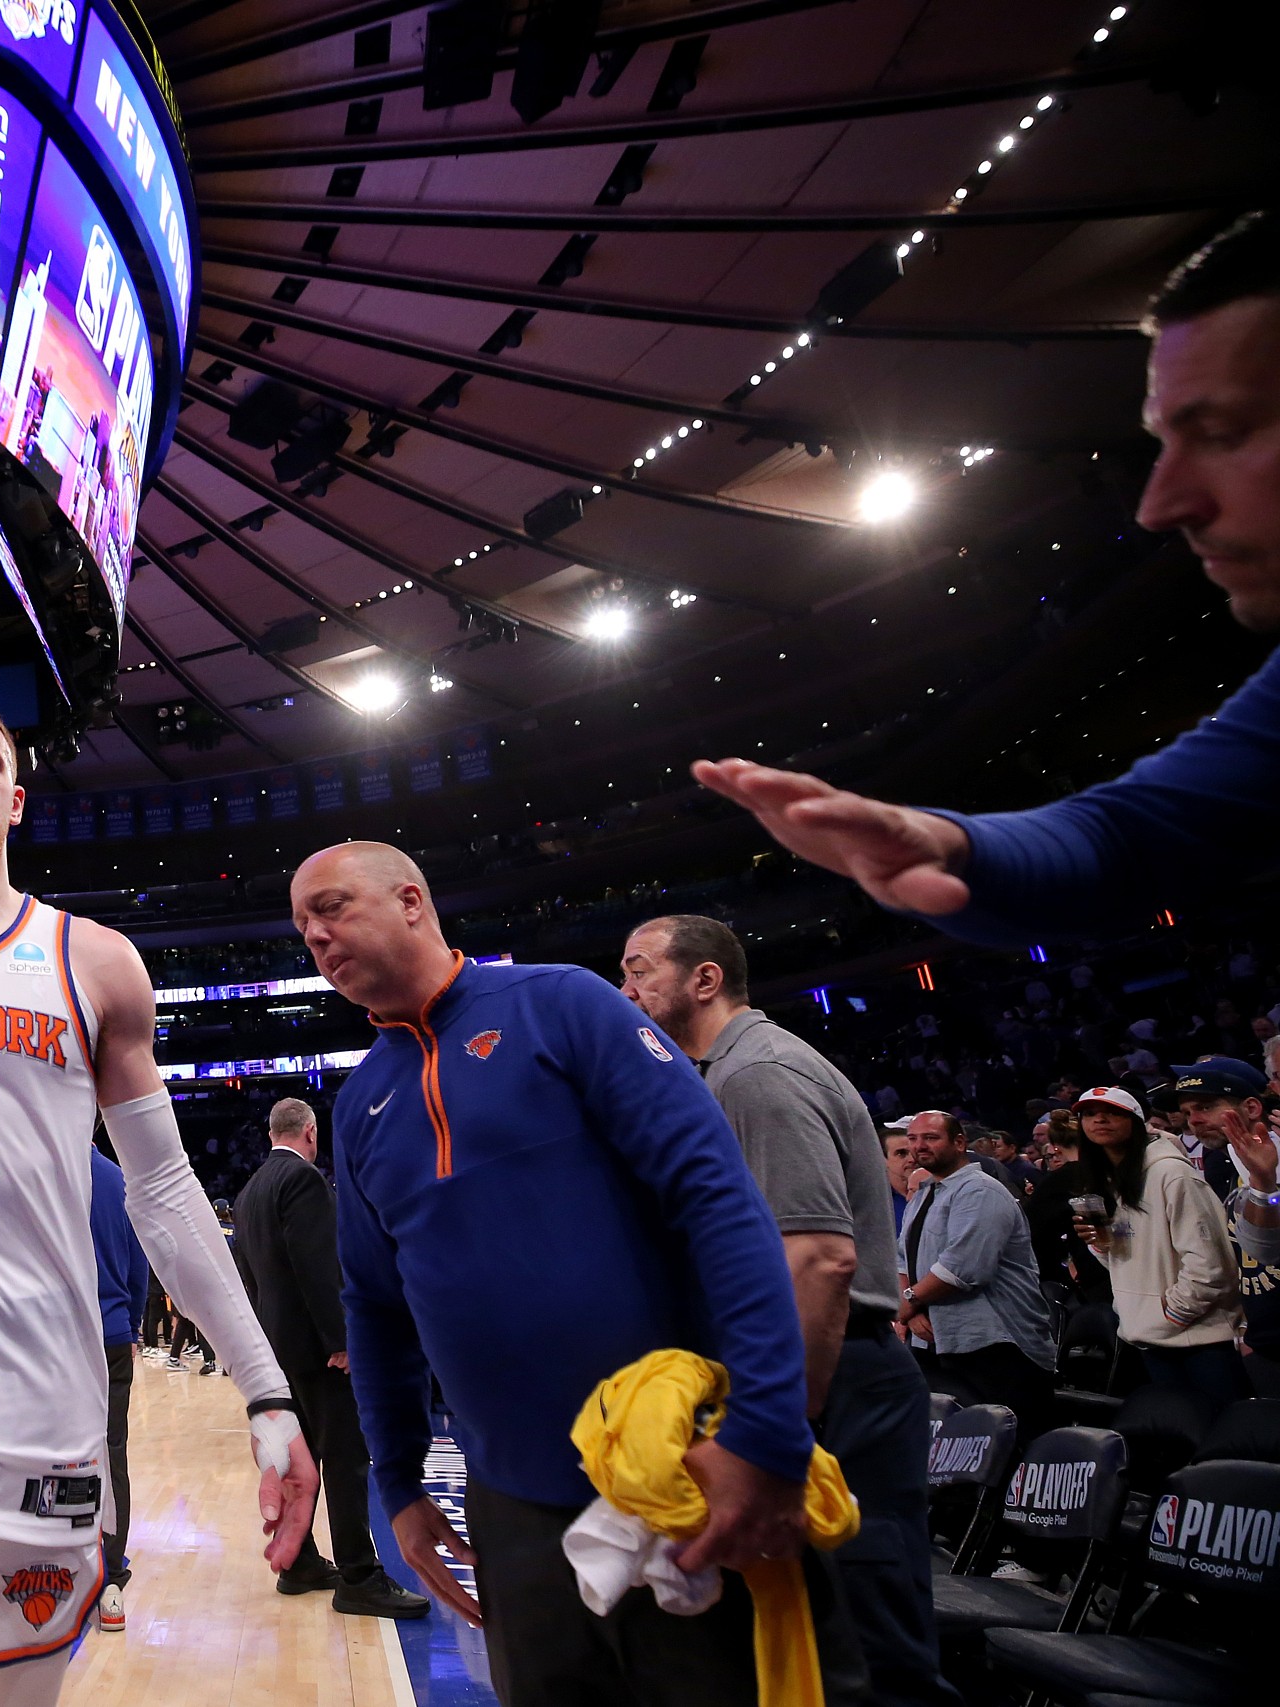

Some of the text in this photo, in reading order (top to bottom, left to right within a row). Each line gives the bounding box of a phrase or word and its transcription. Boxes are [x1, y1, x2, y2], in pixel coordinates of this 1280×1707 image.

[95, 58, 156, 192] NEW
[8, 962, 52, 974] sphere
[930, 1435, 991, 1473] PLAYOFFS
[1021, 1461, 1097, 1510] PLAYOFFS
[1028, 1512, 1054, 1528] Google
[2, 1568, 74, 1595] KNICKS
[1189, 1557, 1234, 1578] Google
[1235, 1566, 1264, 1584] Pixel
